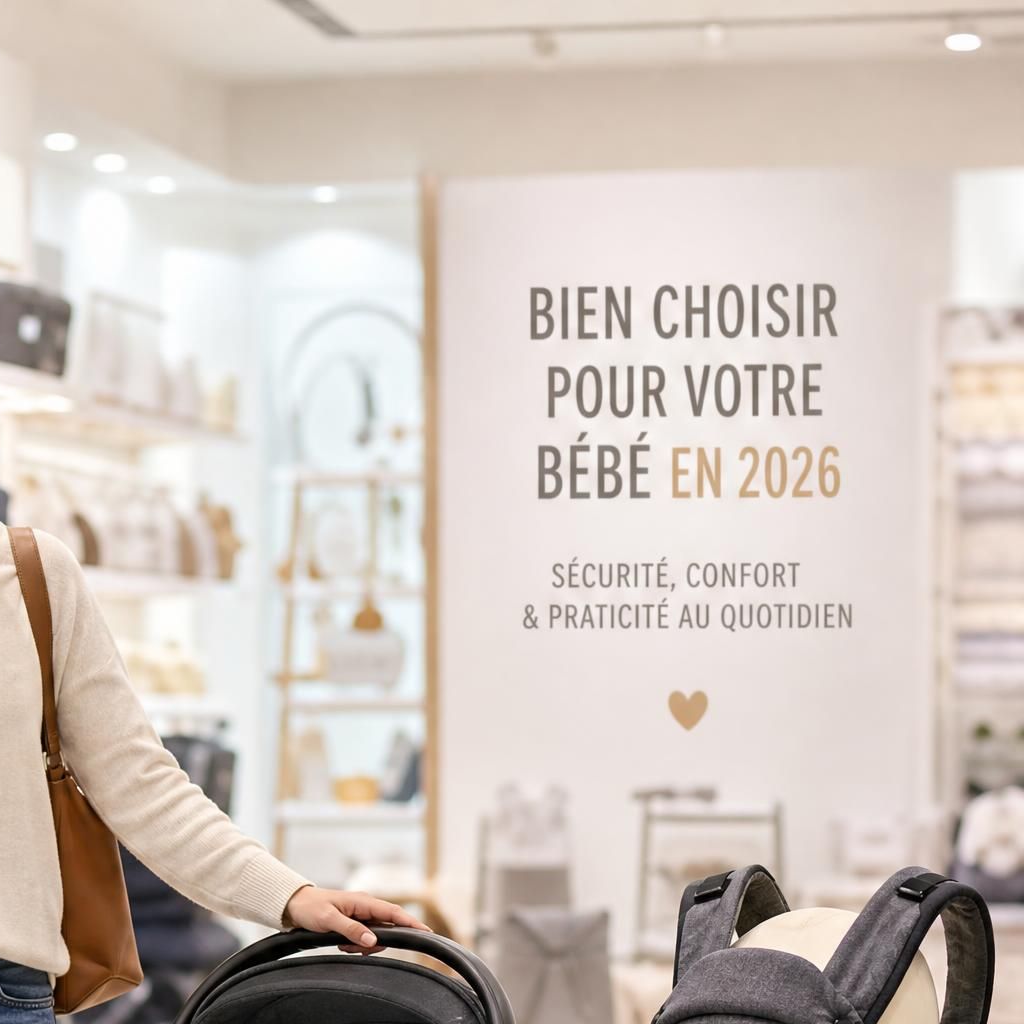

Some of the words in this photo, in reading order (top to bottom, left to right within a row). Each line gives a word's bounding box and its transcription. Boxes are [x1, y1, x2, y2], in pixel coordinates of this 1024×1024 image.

[530, 286, 631, 340] BIEN
[653, 283, 838, 339] CHOISIR
[548, 365, 666, 418] POUR
[684, 363, 822, 417] VOTRE
[538, 432, 650, 499] BÉBÉ
[672, 447, 721, 498] EN
[739, 446, 840, 498] 2026
[552, 557, 675, 592] SÉCURITÉ,
[687, 563, 800, 588] CONFORT
[523, 605, 538, 629] &
[550, 598, 668, 629] PRATICITÉ
[679, 604, 709, 628] AU
[721, 604, 852, 632] QUOTIDIEN
